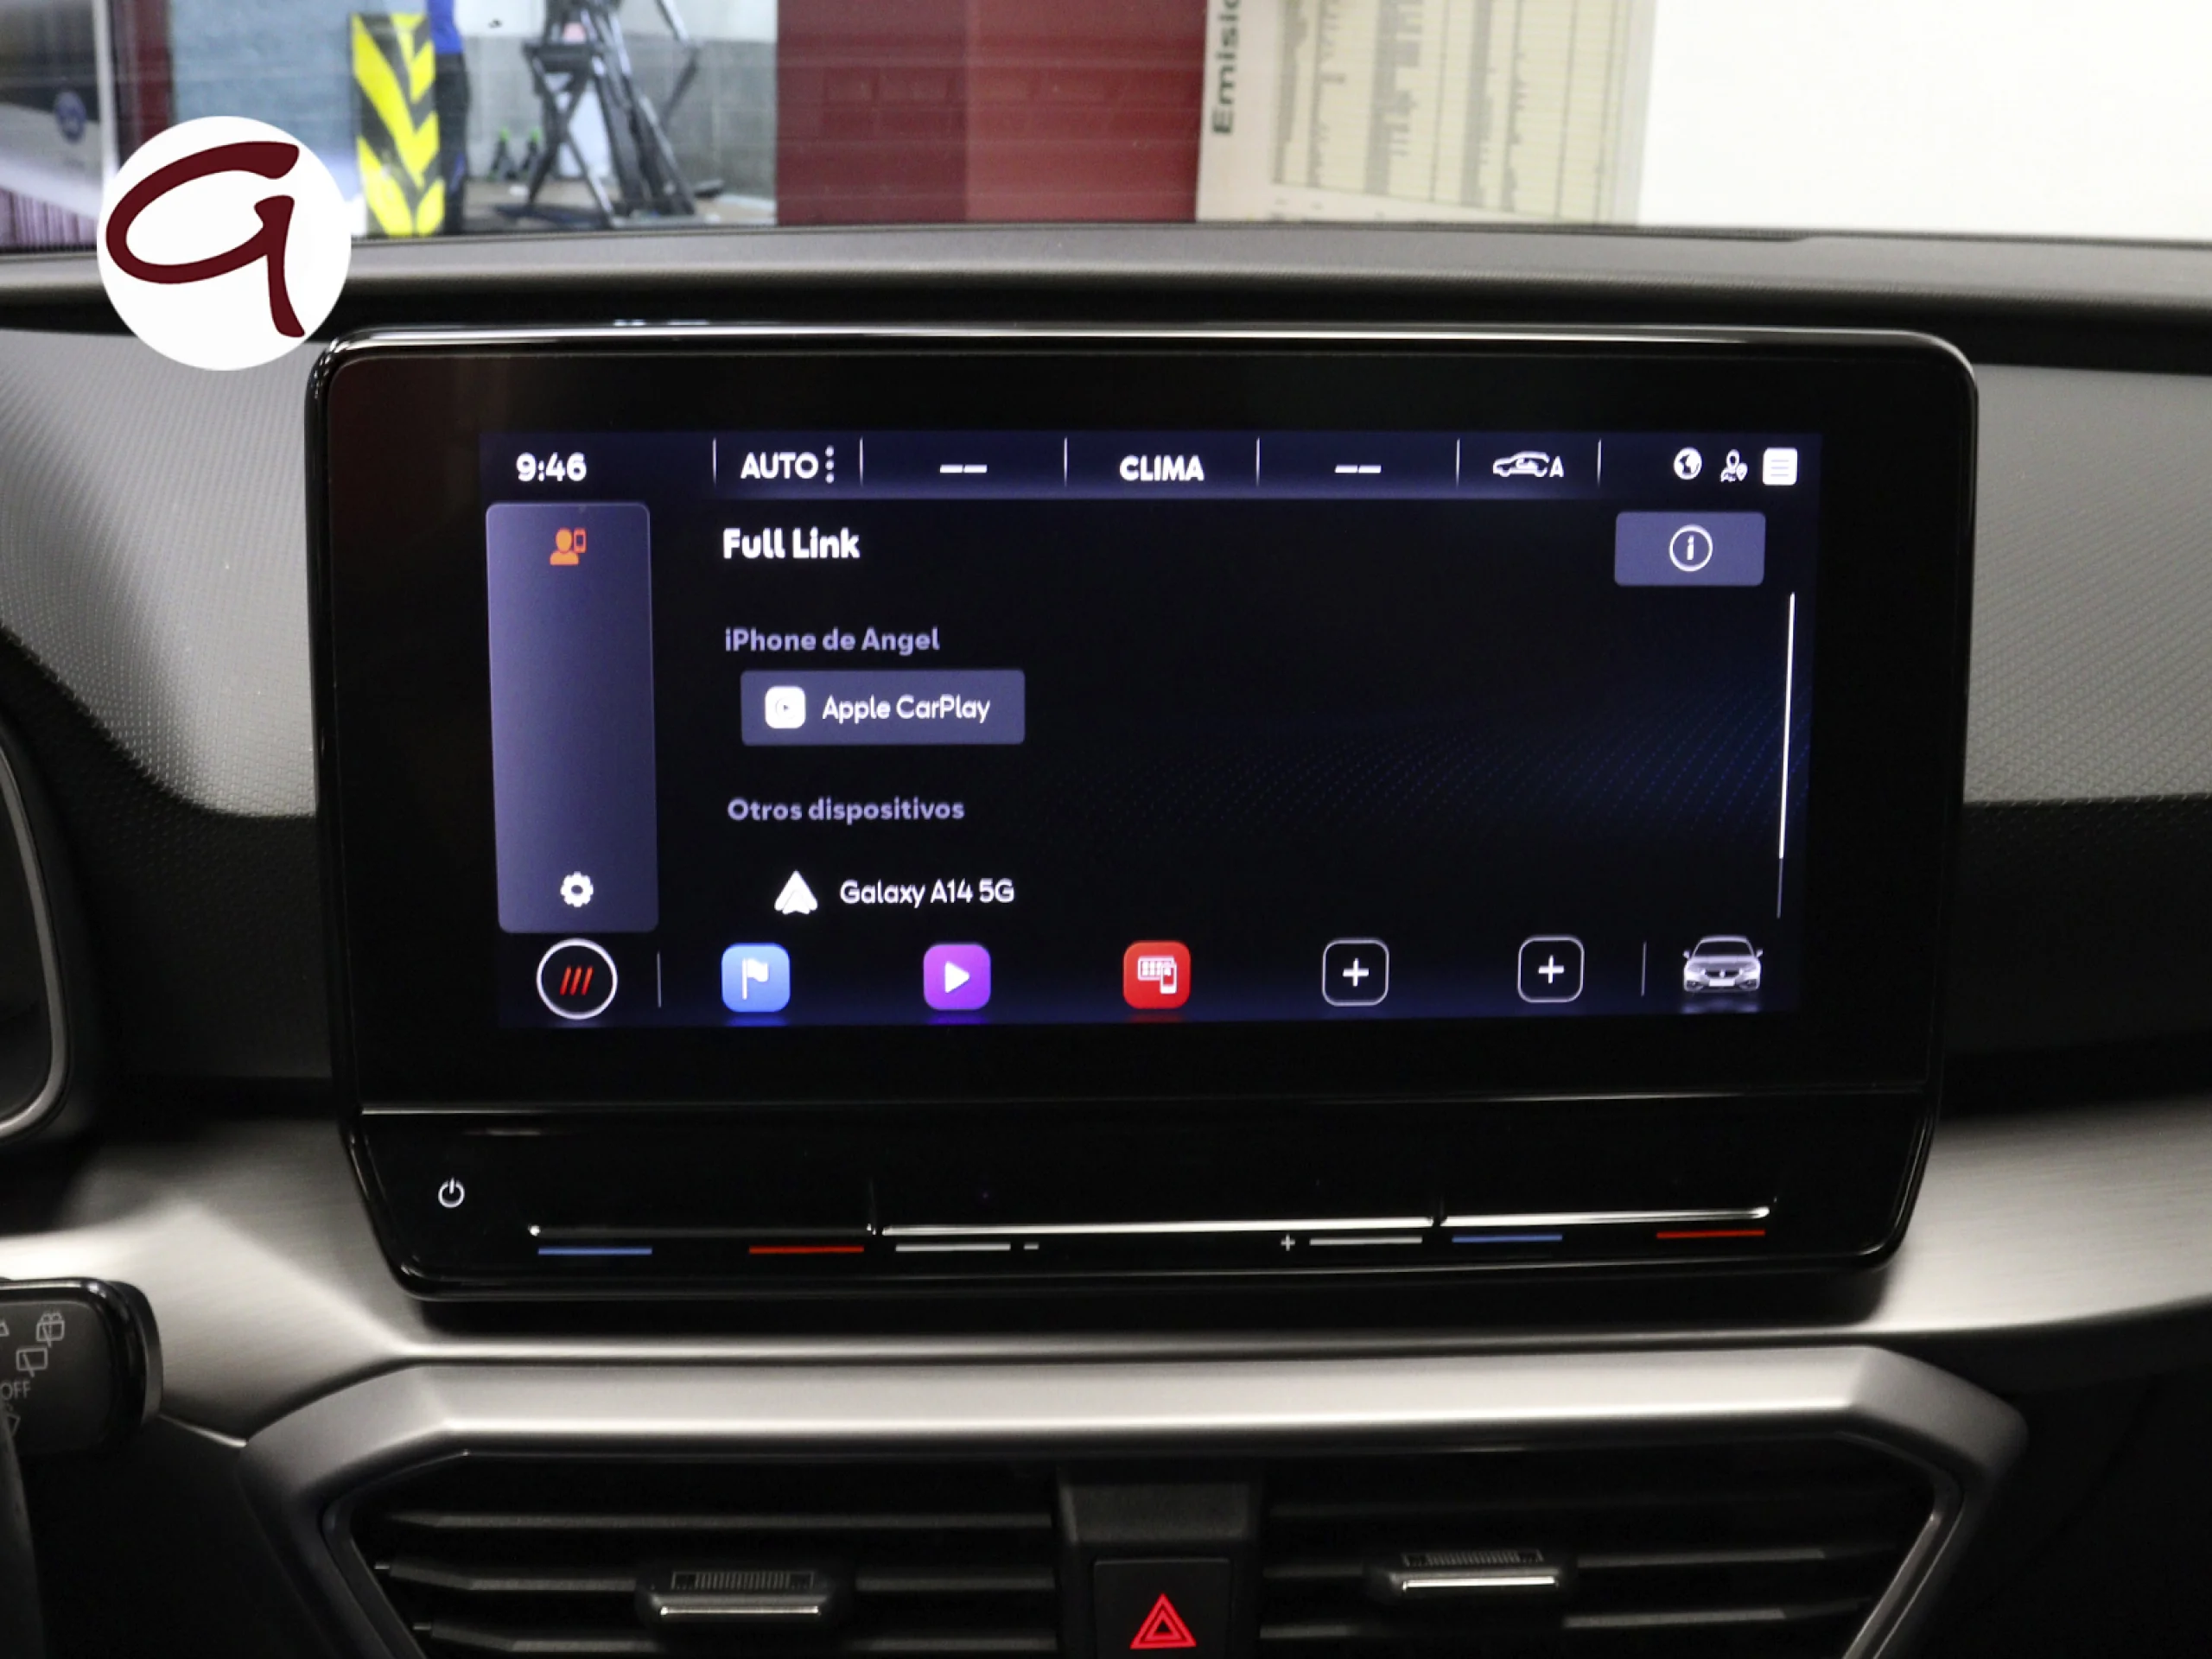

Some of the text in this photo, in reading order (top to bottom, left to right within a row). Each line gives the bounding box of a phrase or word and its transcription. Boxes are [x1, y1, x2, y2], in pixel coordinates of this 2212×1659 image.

[516, 453, 588, 482] 9:46
[741, 453, 819, 480] AUTO
[1120, 455, 1205, 481] CLIMA
[722, 527, 861, 560] Full Link
[724, 628, 940, 657] iPhone de Angel
[822, 694, 991, 724] Apple CarPlay
[727, 797, 965, 825] Otros dispositivos
[839, 878, 1015, 909] Galaxy A14 5G
[0, 1381, 31, 1400] OFF
